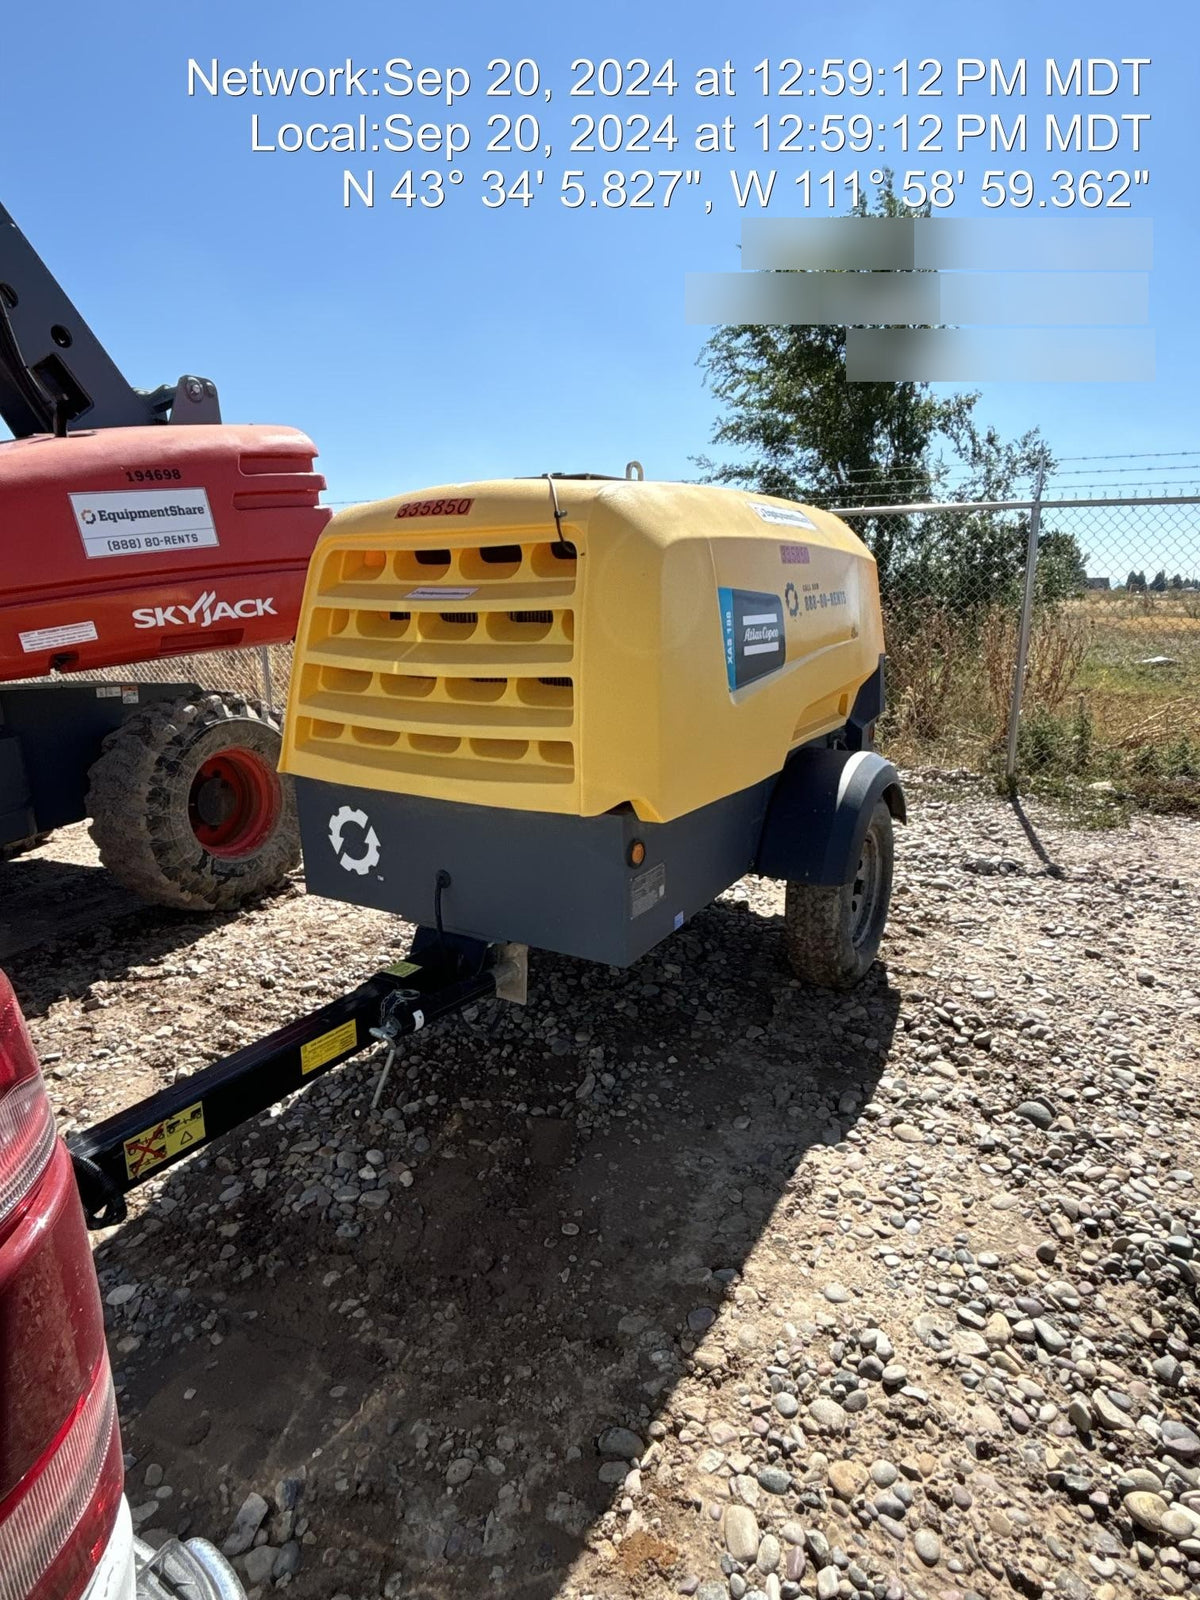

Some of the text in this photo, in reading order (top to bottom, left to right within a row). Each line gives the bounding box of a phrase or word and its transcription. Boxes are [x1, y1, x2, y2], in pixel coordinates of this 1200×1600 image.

[125, 469, 182, 482] 194698
[97, 505, 205, 523] EquipmentShare
[396, 498, 472, 518] 335850
[107, 533, 198, 551] (888) 80-RENTS
[131, 590, 278, 629] SKYJACK
